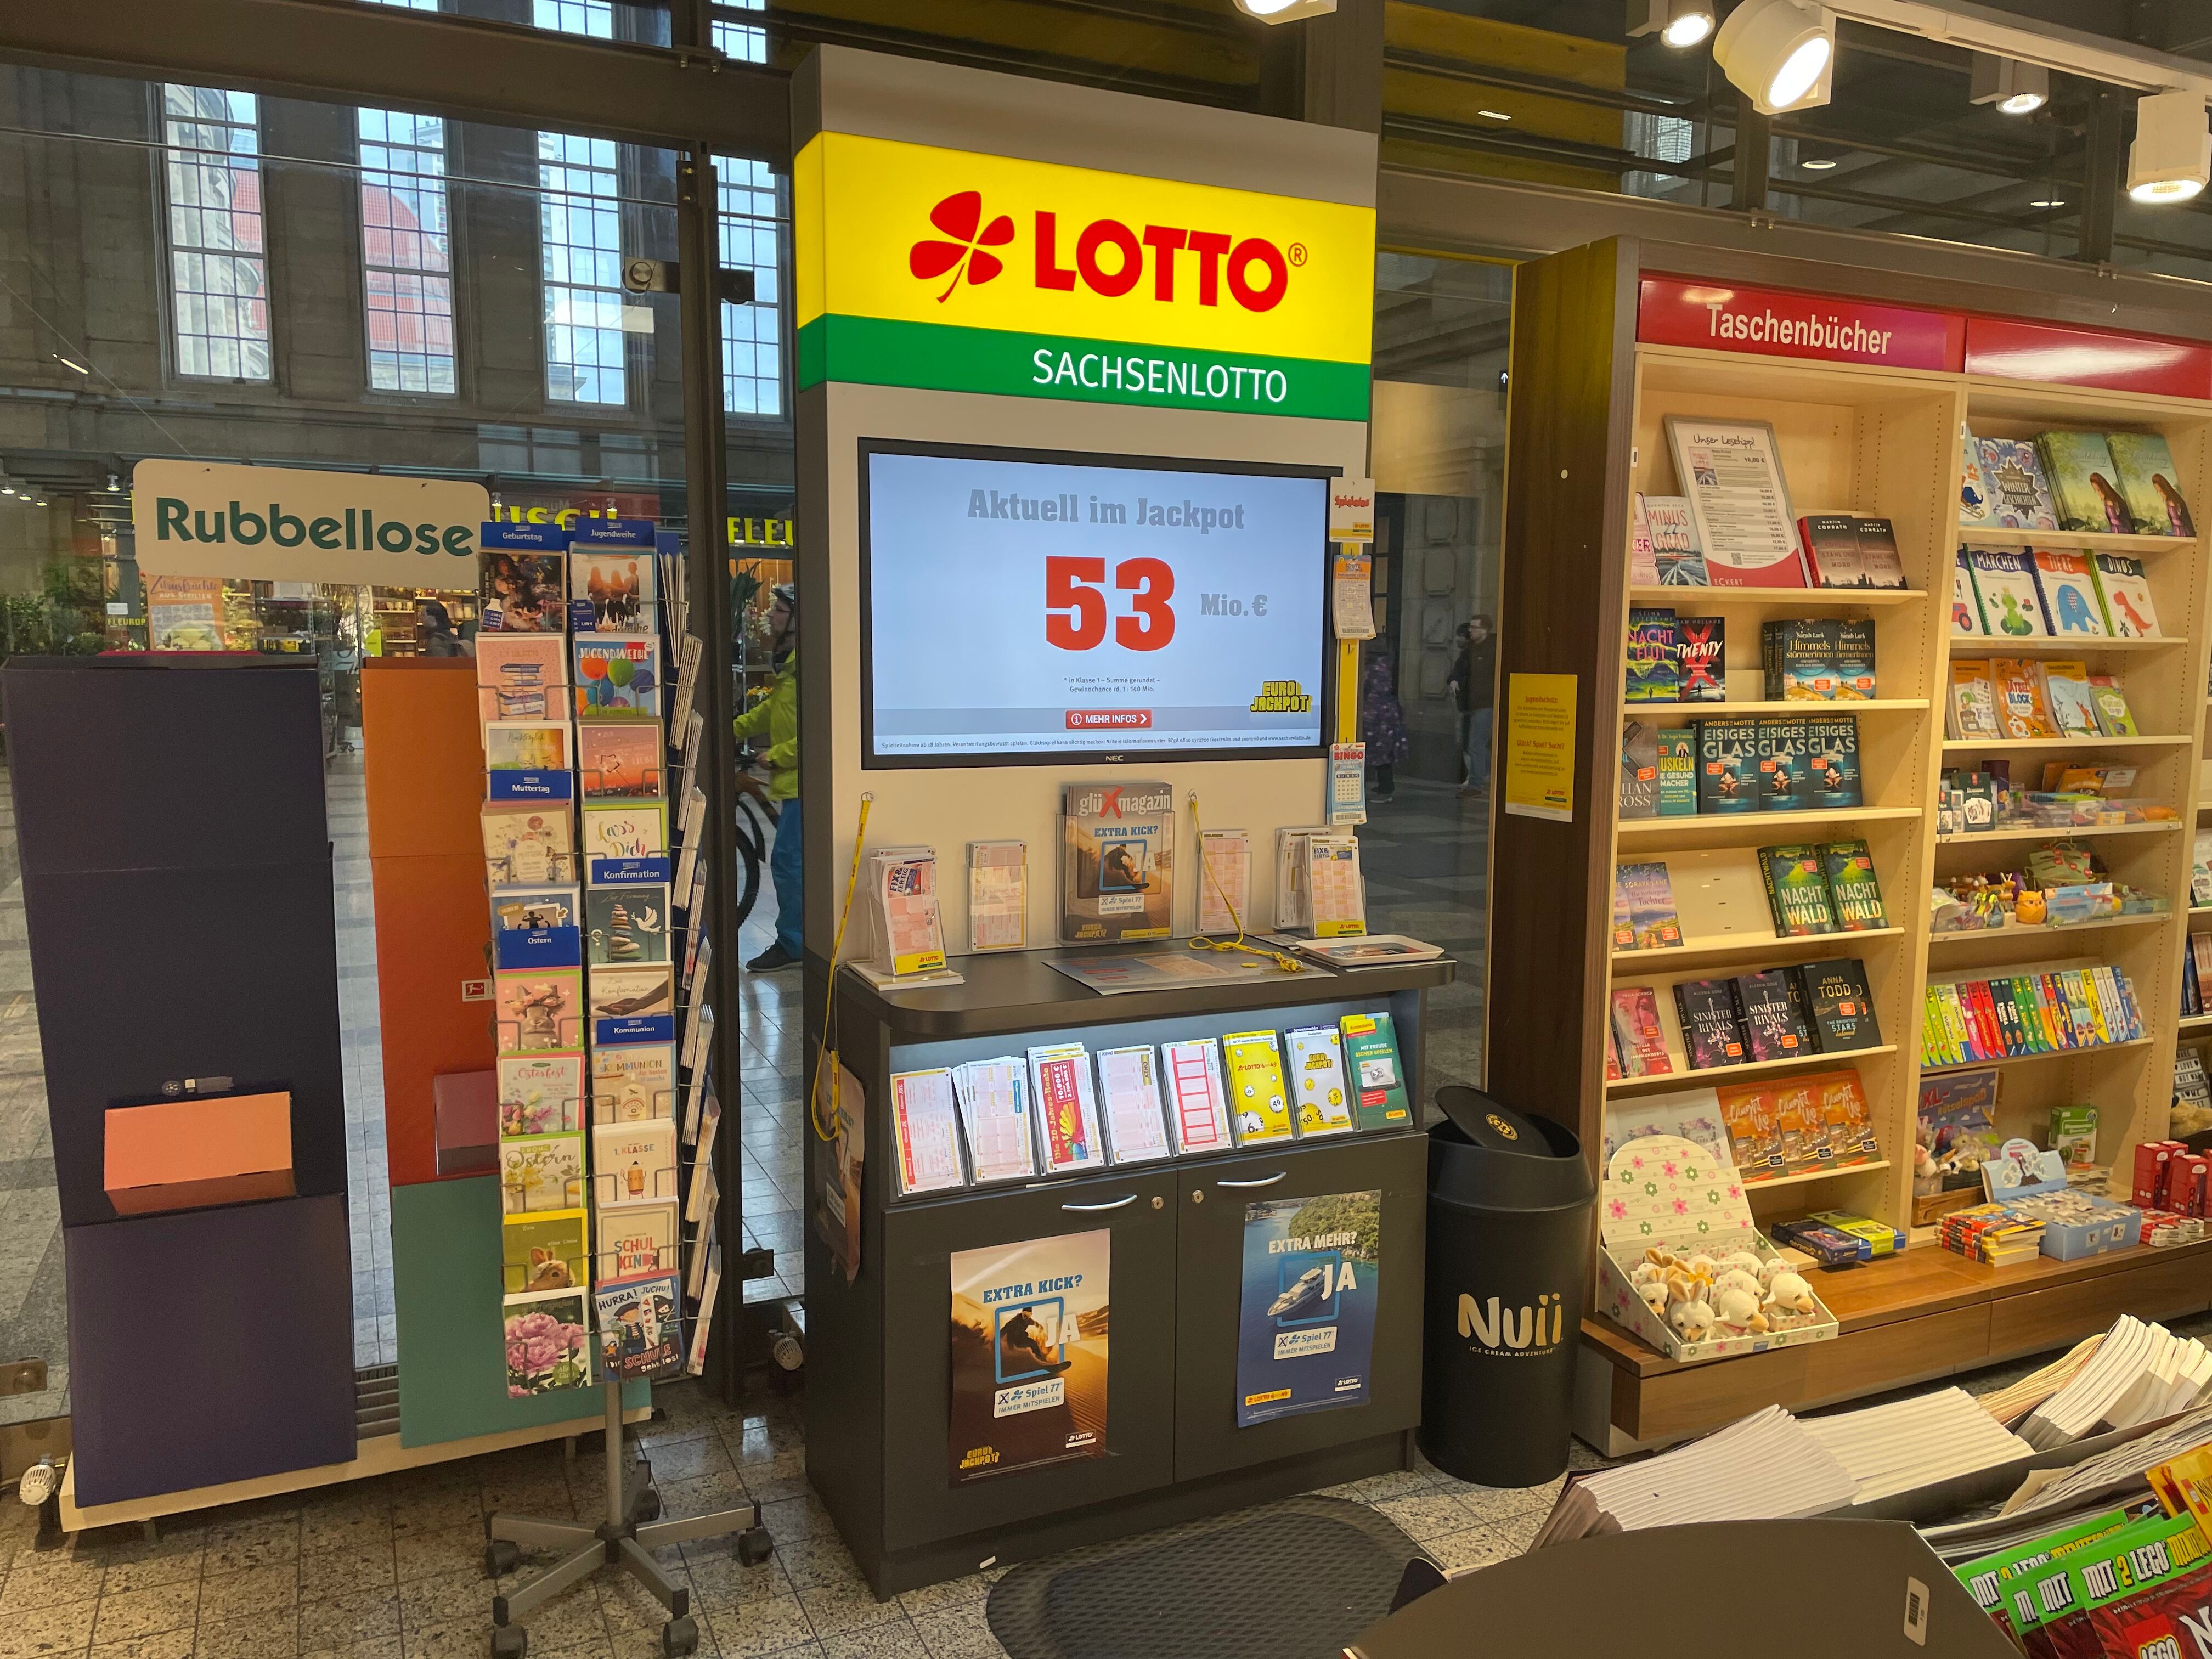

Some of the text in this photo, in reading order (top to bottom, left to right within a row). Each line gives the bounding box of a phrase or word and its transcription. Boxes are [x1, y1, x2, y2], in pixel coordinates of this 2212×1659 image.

[1706, 302, 1891, 355] Taschenbücher
[1032, 349, 1286, 403] SACHSENLOTTO
[1693, 433, 1754, 450] Unser Lesetipp!
[2002, 481, 2030, 494] WINTER
[2003, 495, 2036, 505] GESCHICHTEN
[968, 489, 1244, 534] Aktuell im Jackpot
[1647, 510, 1688, 527] MINUS
[156, 496, 473, 557] Rubbellose
[590, 529, 636, 538] Jugendweihe
[502, 532, 543, 542] Geburtstag
[1656, 533, 1690, 550] GRAD
[1976, 551, 2021, 570] MÄRCHEN
[2047, 554, 2074, 572] TIERE
[2108, 557, 2132, 574] DINOS
[1714, 577, 1743, 586] ECKERT
[1046, 556, 1176, 652] 53
[1628, 630, 1673, 645] NACHT
[1790, 640, 1830, 650] Himmels
[578, 647, 650, 660] JUGENDWEIHE
[1637, 646, 1666, 661] FLUT
[1677, 640, 1724, 658] TWENTY
[1263, 681, 1298, 696] EURO
[1250, 696, 1309, 712] JACKPOT
[2009, 693, 2030, 704] BLOCK
[1085, 714, 1137, 723] MEHR INFOS
[1704, 728, 1755, 741] EISIGES
[1758, 726, 1805, 739] EISIGES
[1808, 725, 1854, 737] EISIGES
[1703, 741, 1756, 758] GLAS
[1758, 739, 1806, 756] GLAS
[1808, 737, 1855, 754] GLAS
[1334, 751, 1364, 761] BINGO
[512, 783, 550, 794] Muttertag
[597, 820, 635, 843] Lass
[1094, 825, 1159, 837] EXTRA KICK?
[609, 838, 646, 859] Dich
[1133, 851, 1156, 872] JA
[603, 870, 660, 879] Konfirmation
[1781, 885, 1823, 905] NACHT
[1836, 882, 1877, 901] NACHT
[1638, 896, 1666, 906] Tochter
[1785, 904, 1827, 926] WALD
[1840, 899, 1882, 921] WALD
[1822, 975, 1844, 985] ANNA
[1818, 984, 1852, 998] TODD
[1694, 1009, 1732, 1022] SINISTER
[1754, 1012, 1788, 1025] RIVALS
[614, 1025, 655, 1034] Kommunion
[1699, 1021, 1733, 1033] RIVALS
[1831, 1023, 1857, 1032] STARS
[2180, 1060, 2193, 1070] LOVE
[517, 1067, 568, 1080] Osterfest
[1730, 1096, 1763, 1122] Caught
[621, 1143, 654, 1154] KLASSE
[614, 1237, 658, 1252] SCHUL
[1269, 1231, 1358, 1254] EXTRA MEHR?
[641, 1284, 670, 1294] JUCHU!
[984, 1274, 1083, 1304] EXTRA KICK?
[1321, 1262, 1357, 1301] JA
[599, 1289, 638, 1311] HURRA!
[1458, 1293, 1562, 1349] Nuii
[1045, 1313, 1081, 1347] JA
[1301, 1333, 1322, 1344] Spiel
[1278, 1342, 1331, 1356] IMMER MITSPIELEN
[1514, 1347, 1554, 1357] ADVENTURE
[641, 1363, 660, 1372] geht
[1025, 1385, 1048, 1399] Spiel
[998, 1395, 1060, 1413] IMMER MITSPIELEN
[1075, 1432, 1093, 1441] LOTTO
[967, 1446, 991, 1458] EURO
[960, 1452, 1000, 1469] JACKPOT
[2081, 1559, 2120, 1601] MIT
[2115, 1554, 2135, 1588] 2
[1970, 1570, 2001, 1609] MIT
[2037, 1571, 2075, 1613] MIT
